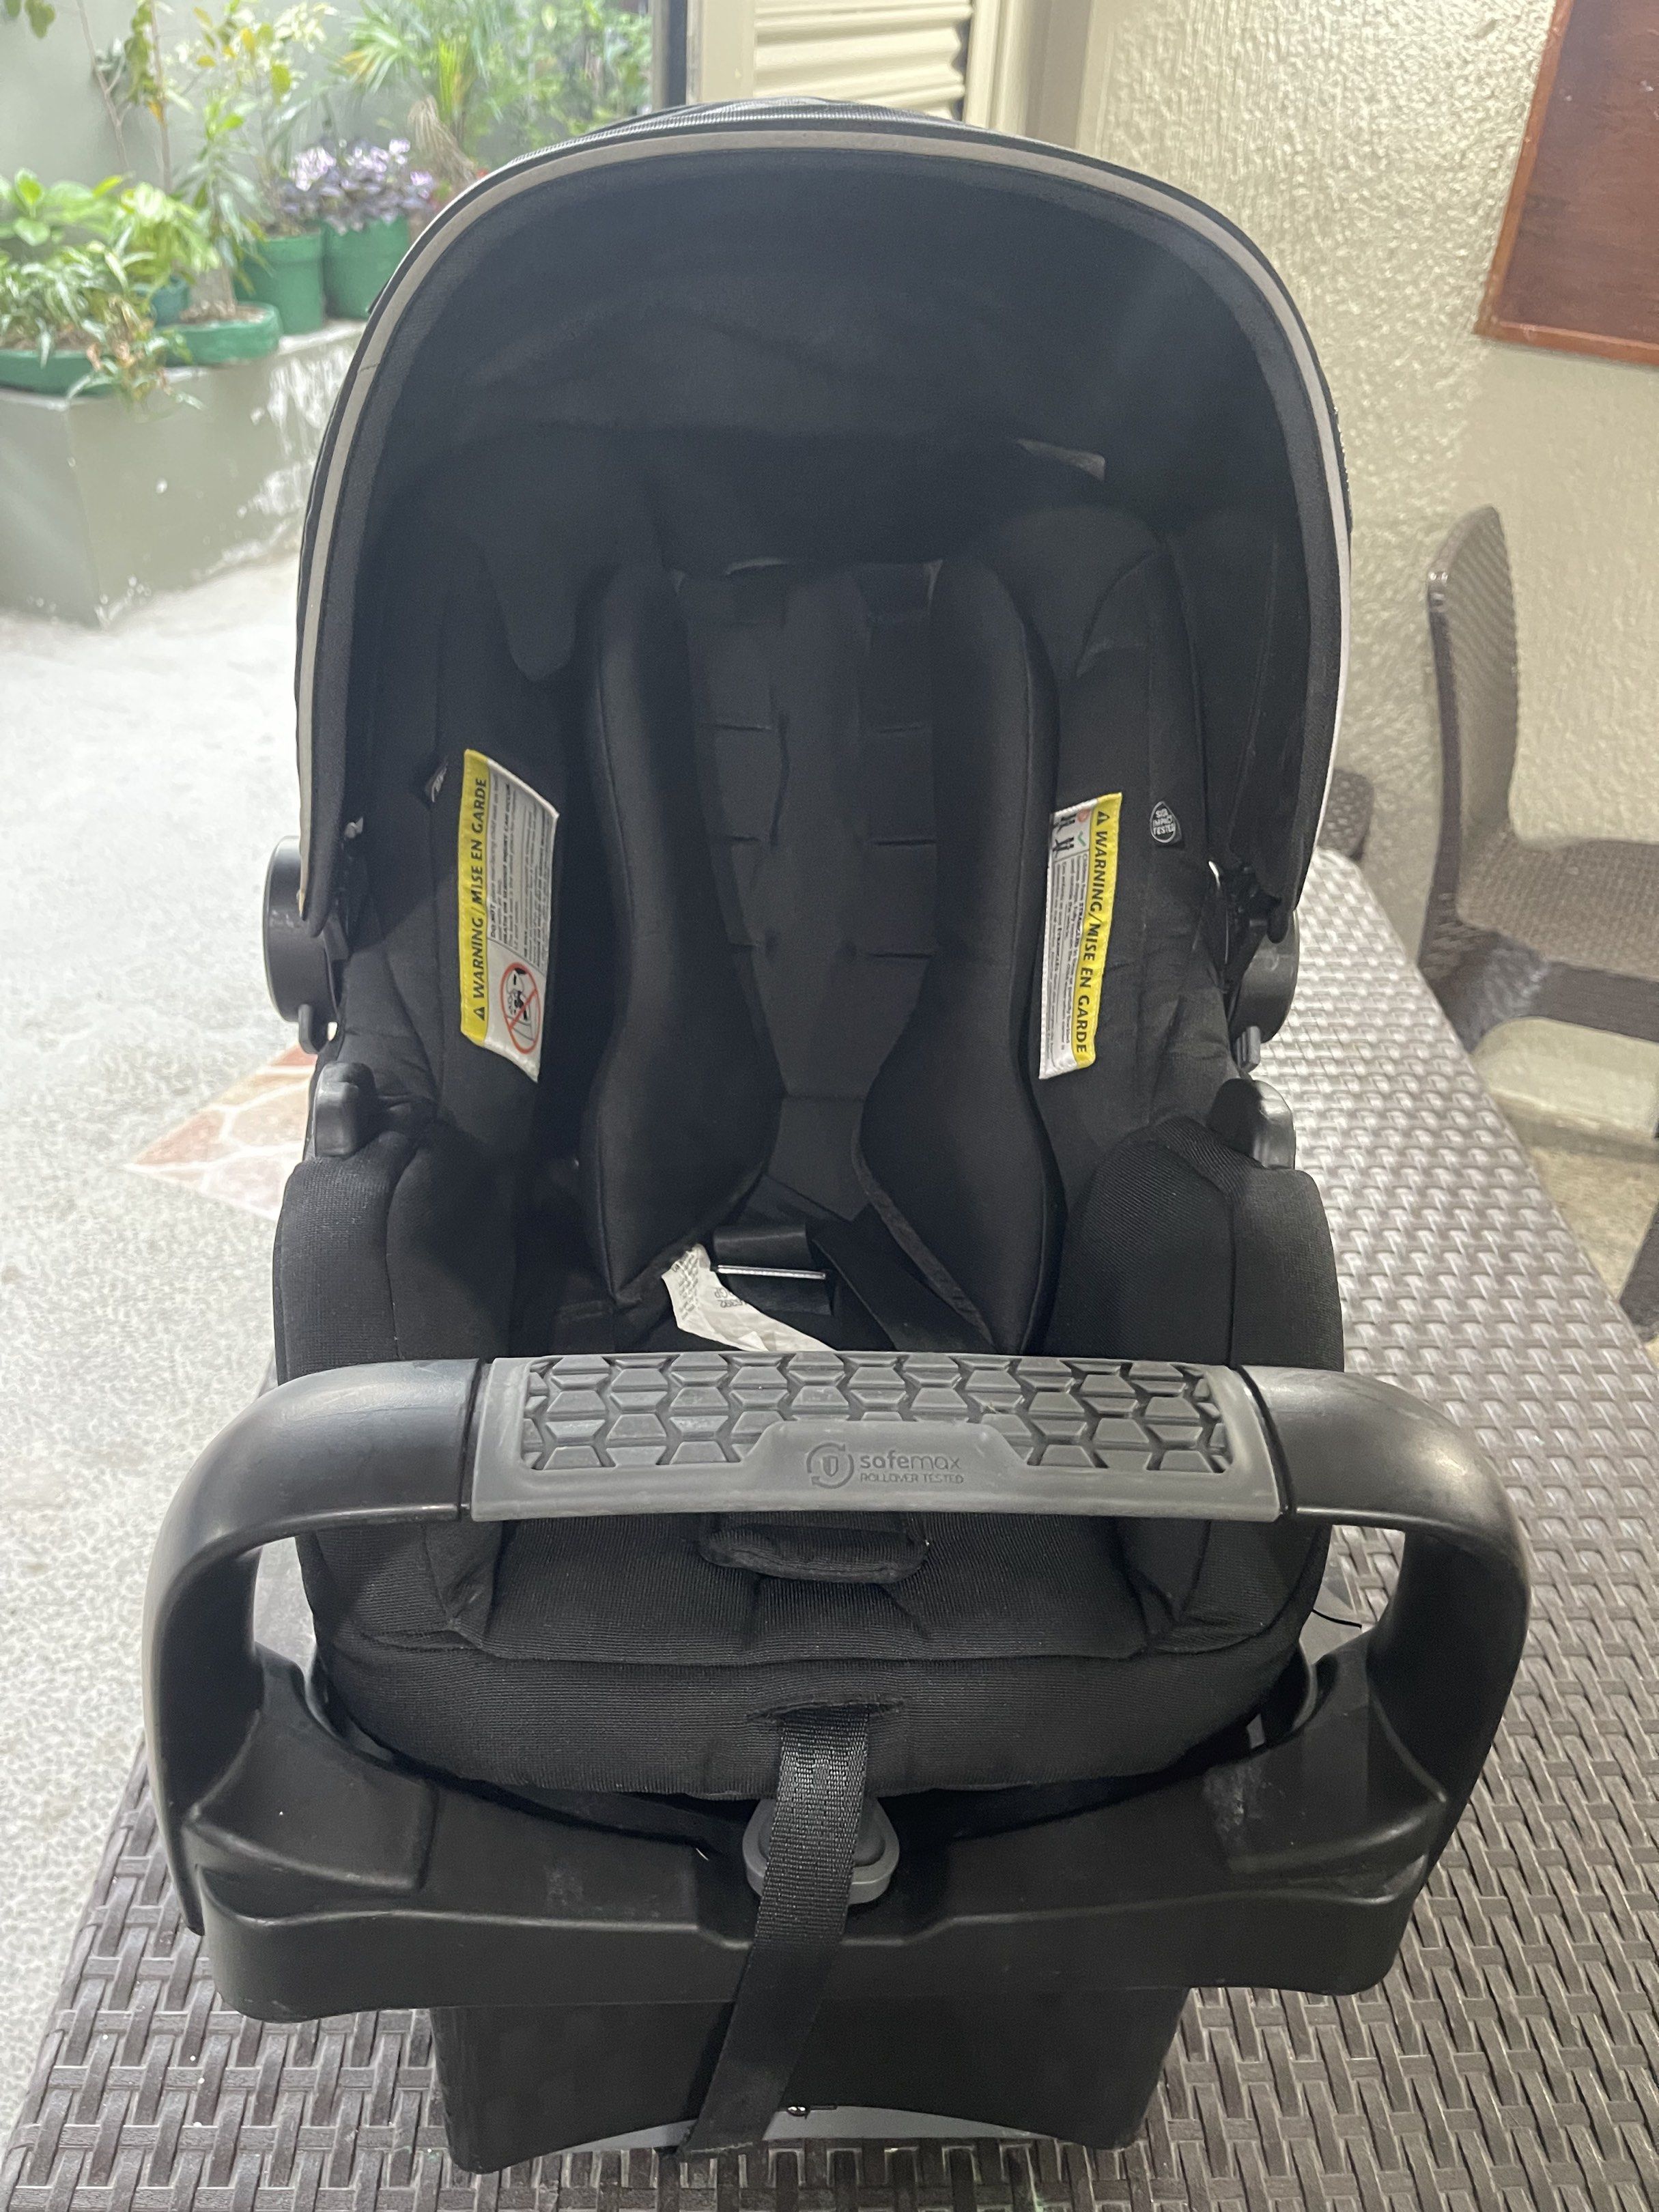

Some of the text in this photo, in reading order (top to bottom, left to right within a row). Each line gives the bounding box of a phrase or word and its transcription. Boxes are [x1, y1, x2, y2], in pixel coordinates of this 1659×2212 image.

[472, 778, 487, 834] GARDE
[470, 839, 483, 860] EN
[1079, 967, 1092, 988] EN
[1077, 995, 1090, 1053] GARDE
[860, 1449, 962, 1470] safemax
[923, 1473, 964, 1484] TESTED
